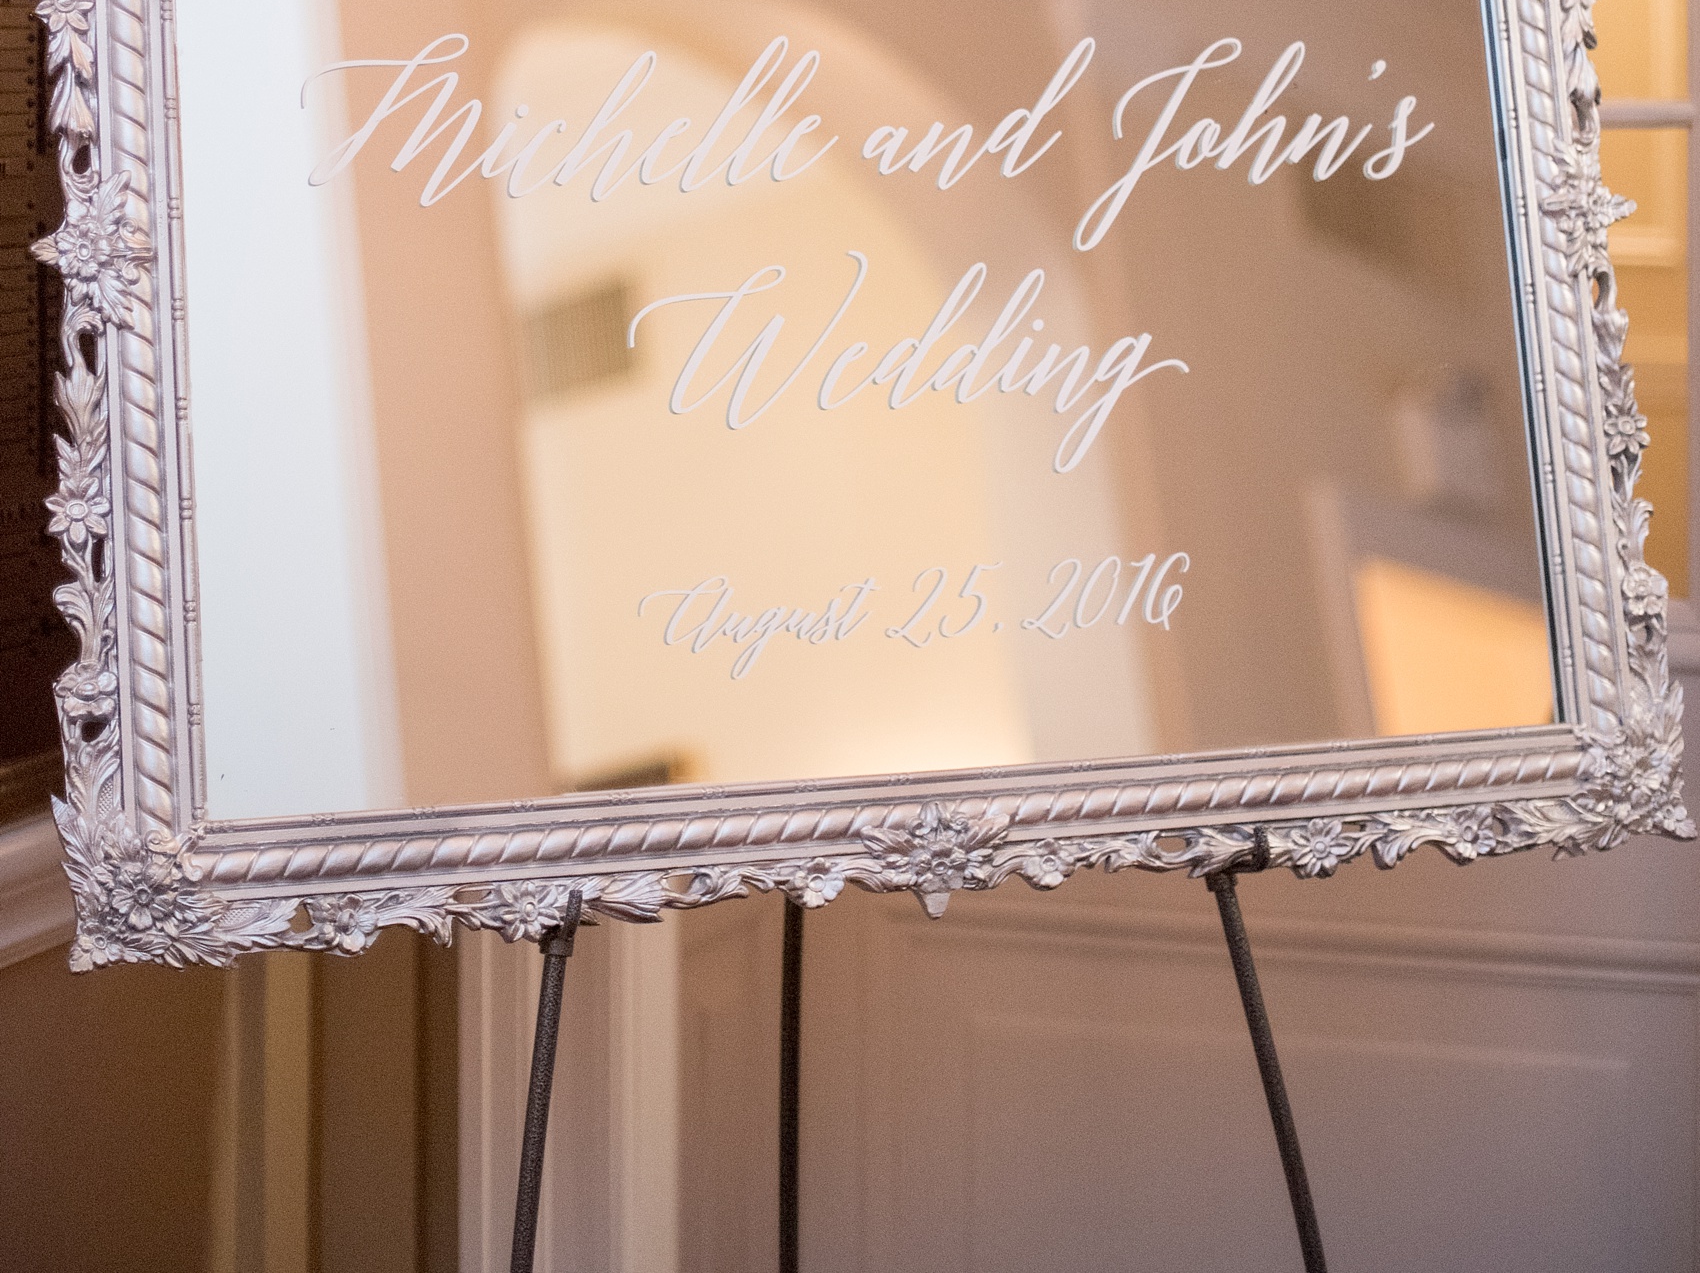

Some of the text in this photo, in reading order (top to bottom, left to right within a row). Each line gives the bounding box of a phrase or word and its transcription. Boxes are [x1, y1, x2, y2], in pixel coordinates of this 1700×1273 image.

[300, 33, 1435, 252] Michelle and John's
[627, 250, 1190, 474] Wedding
[637, 576, 880, 680] August
[1020, 551, 1191, 640] 2016
